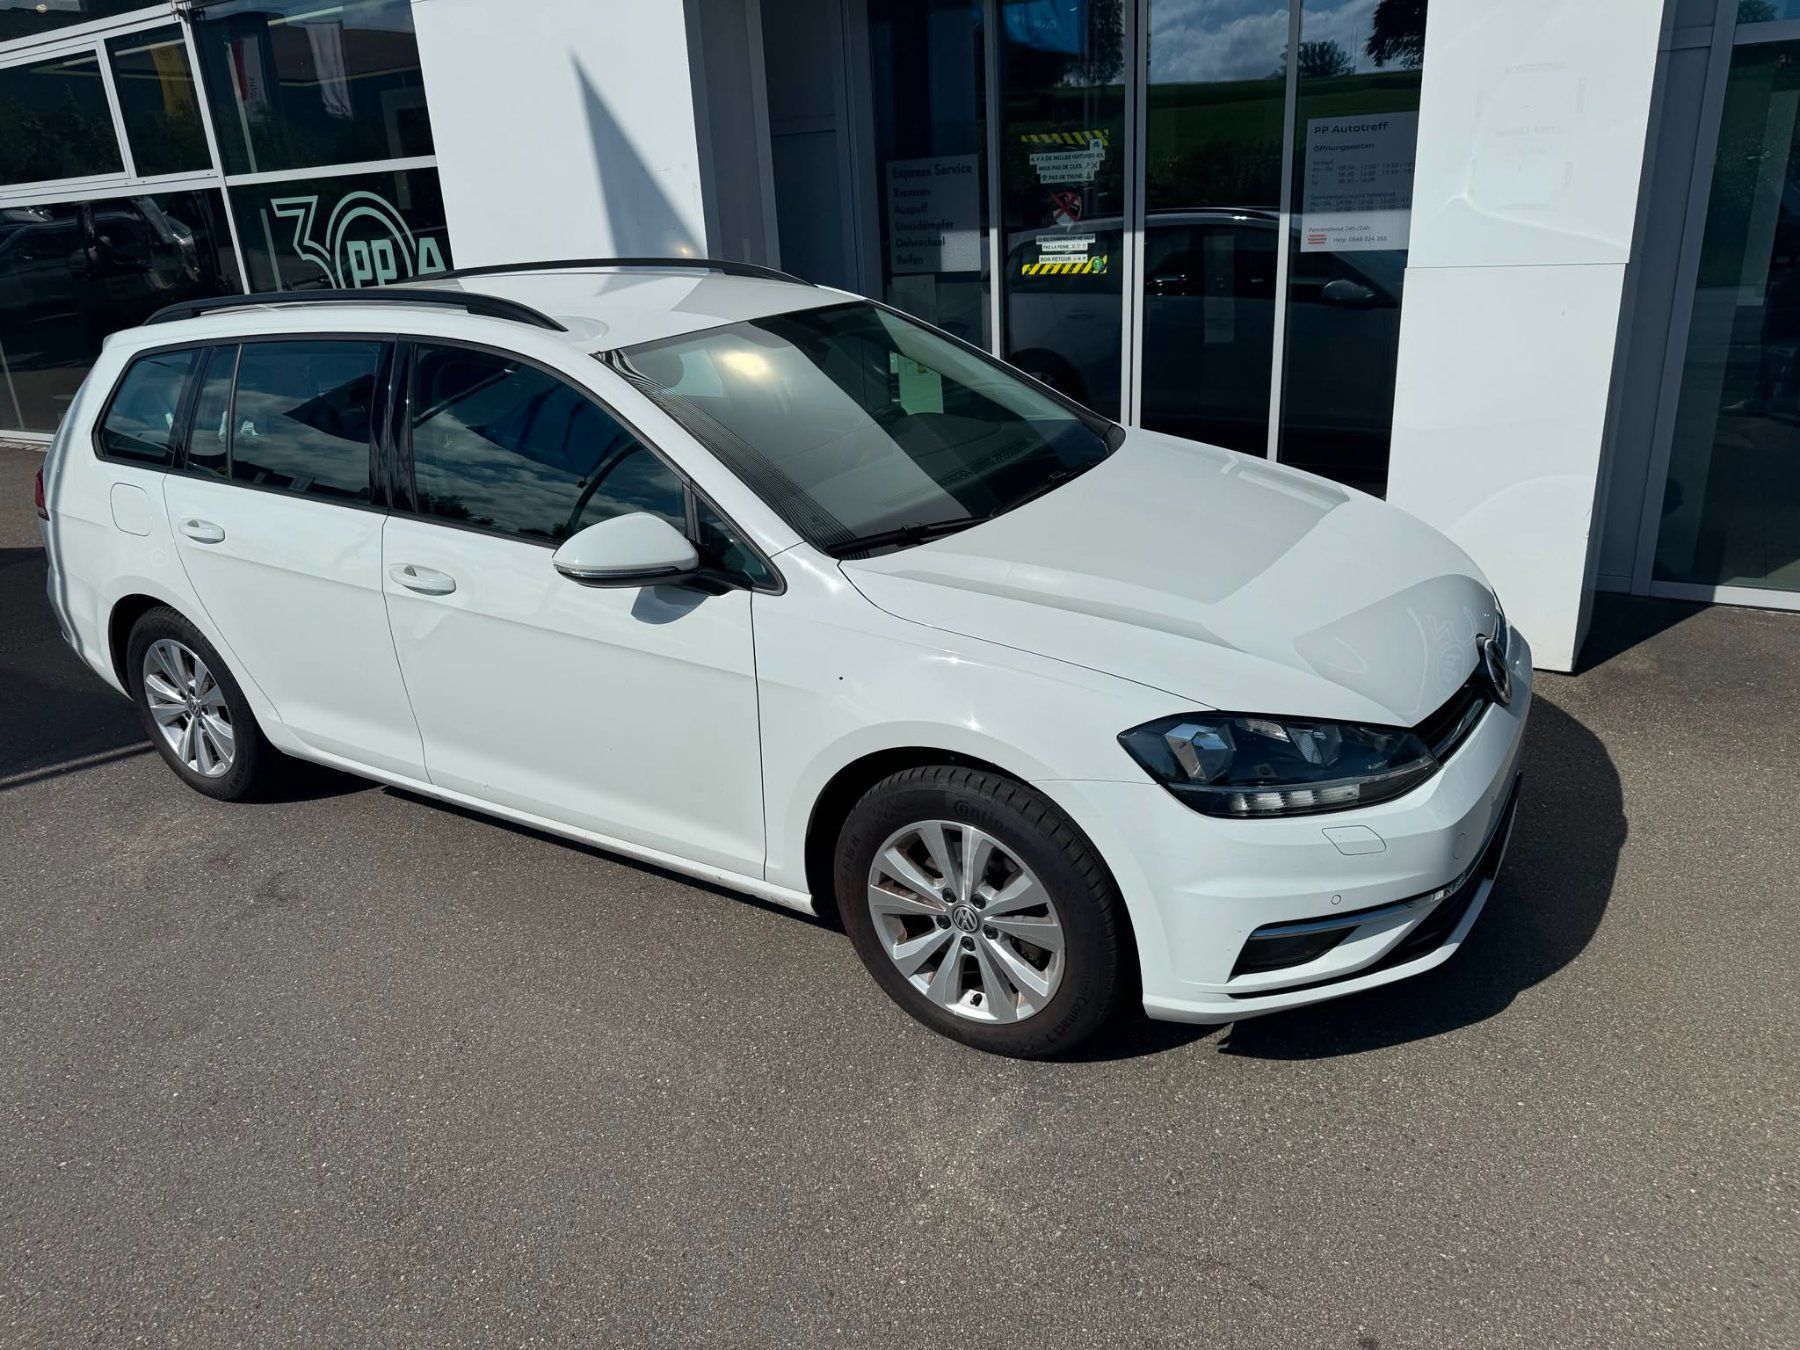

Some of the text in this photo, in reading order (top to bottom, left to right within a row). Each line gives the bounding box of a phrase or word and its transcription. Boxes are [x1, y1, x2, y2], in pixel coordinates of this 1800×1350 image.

[1314, 121, 1389, 134] PP Autotreff
[892, 162, 973, 180] Express Service
[893, 187, 931, 197] Bremsen
[894, 204, 928, 215] Auspuff
[896, 255, 924, 265] Reifen
